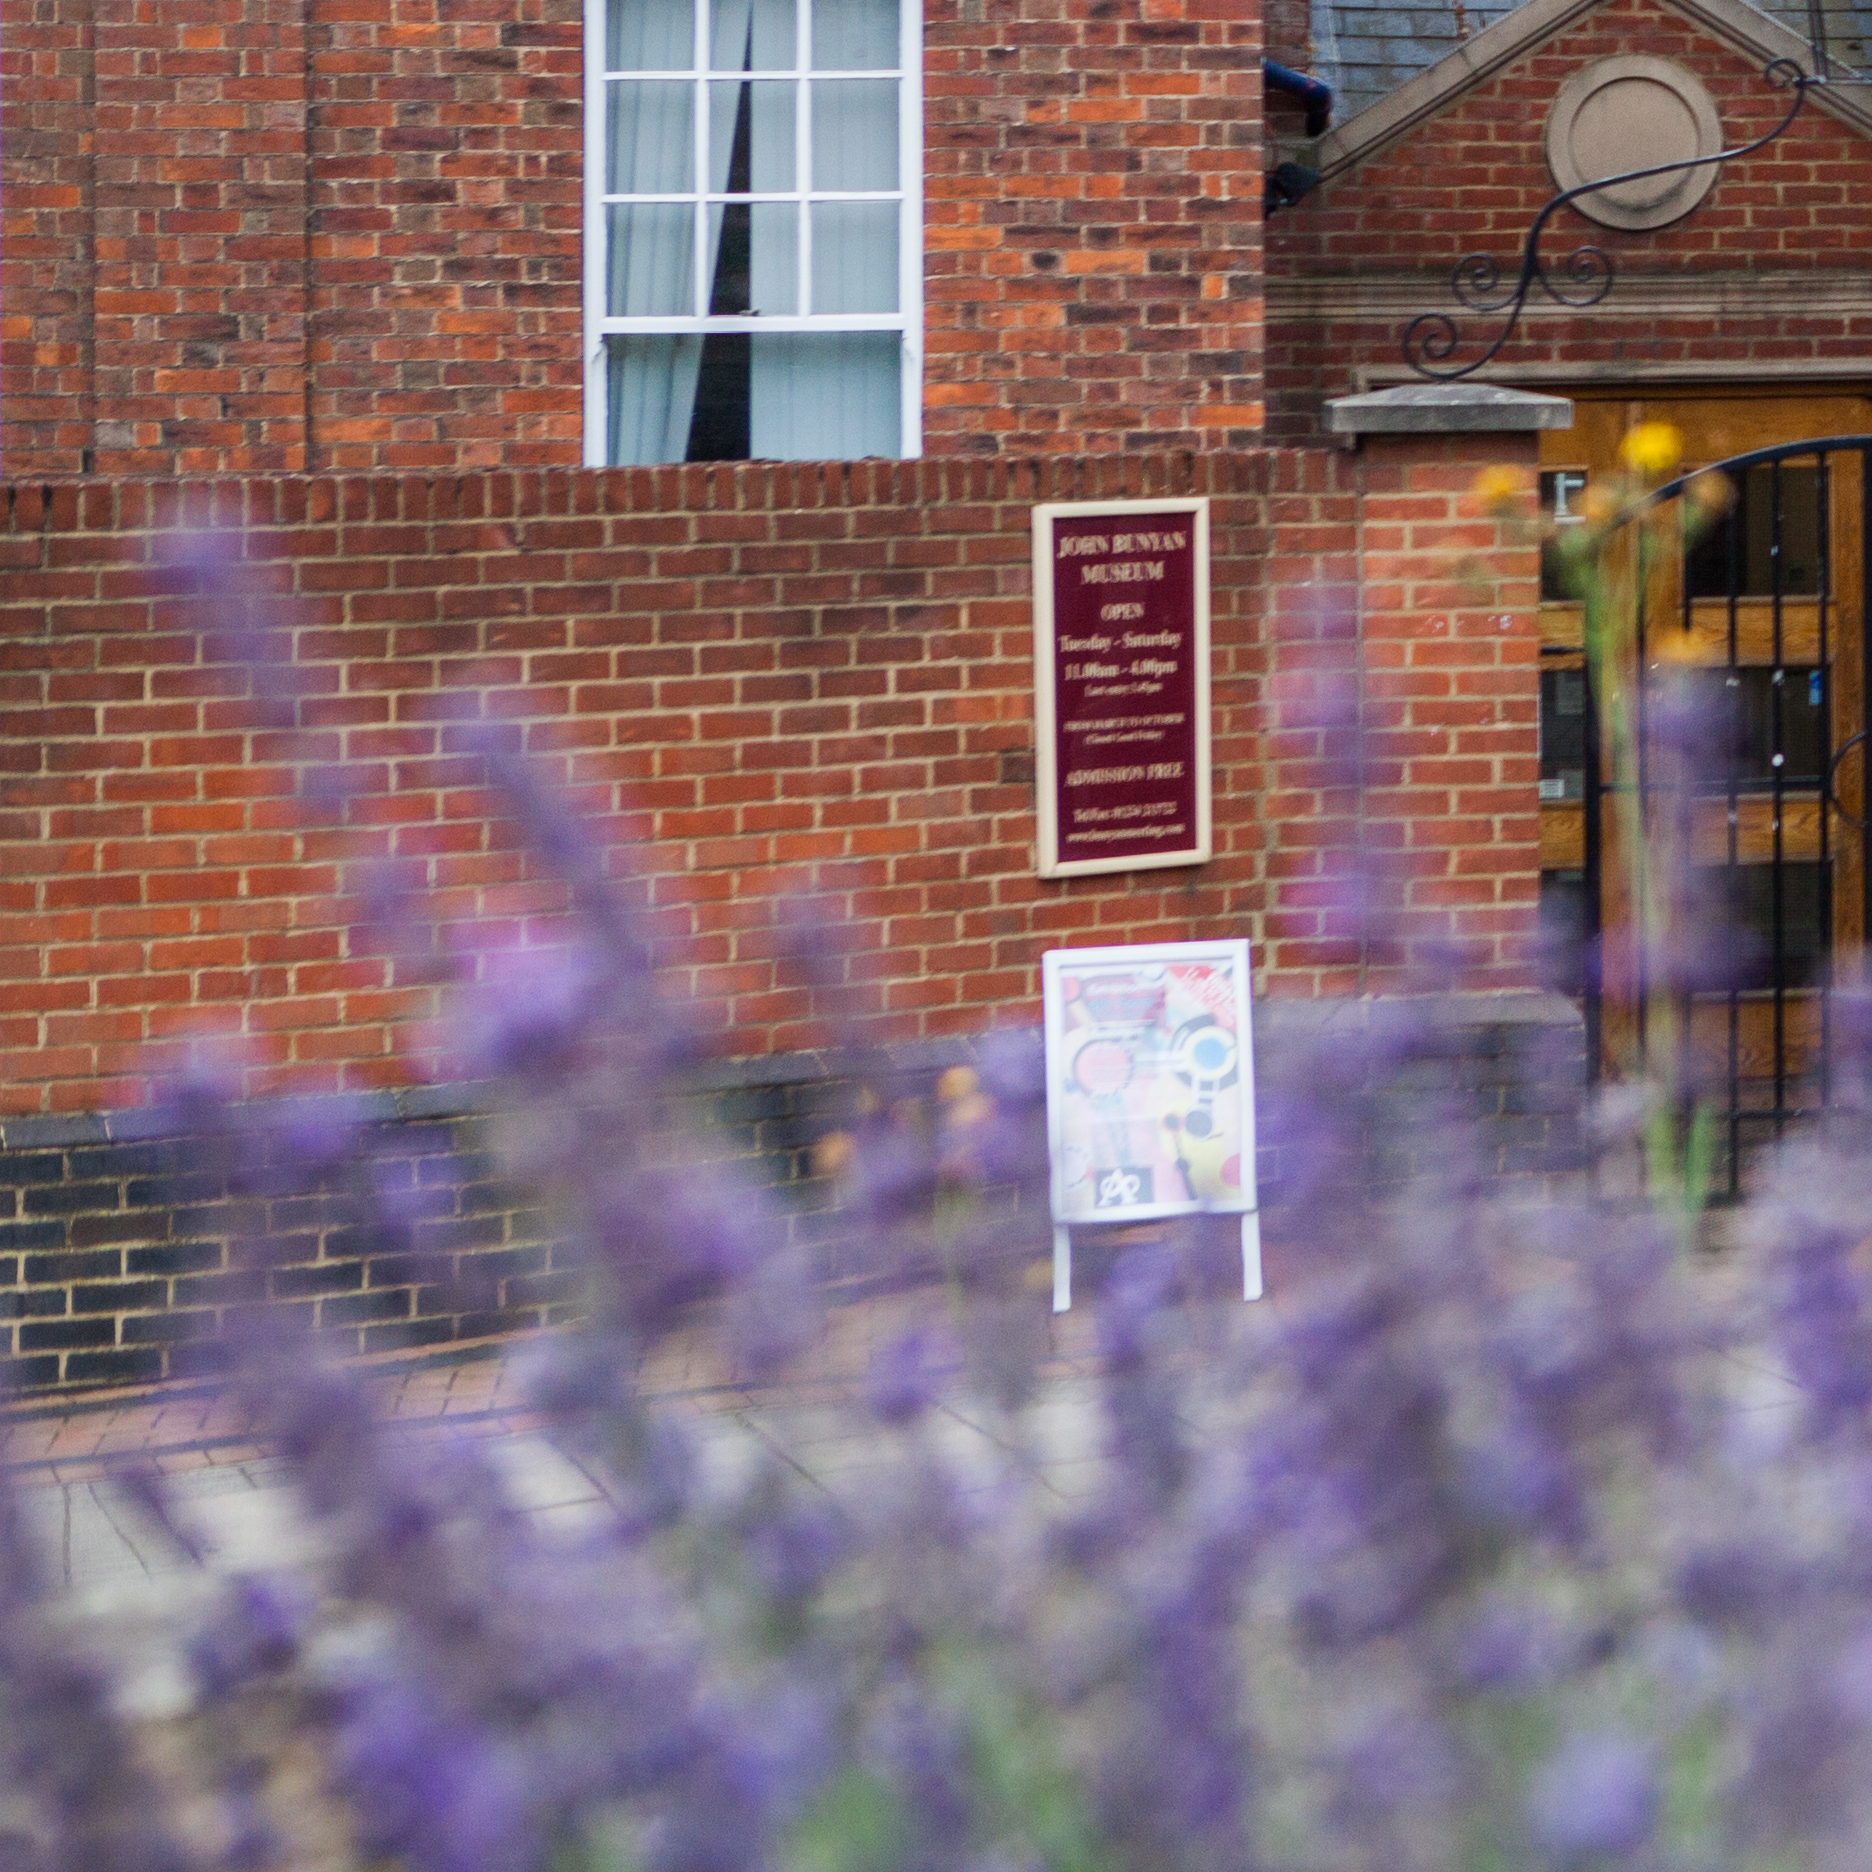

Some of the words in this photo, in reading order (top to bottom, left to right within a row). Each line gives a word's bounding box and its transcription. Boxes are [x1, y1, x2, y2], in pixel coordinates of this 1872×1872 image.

[1058, 536, 1110, 559] JOHN
[1112, 533, 1187, 554] BUNYAN
[1082, 562, 1165, 585] MUSEUM
[1101, 604, 1145, 621] OPEN
[1059, 635, 1112, 654] Tuesday
[1123, 631, 1183, 650] Saturday
[1065, 768, 1145, 787] ADMISSION
[1147, 763, 1185, 780] FREE
